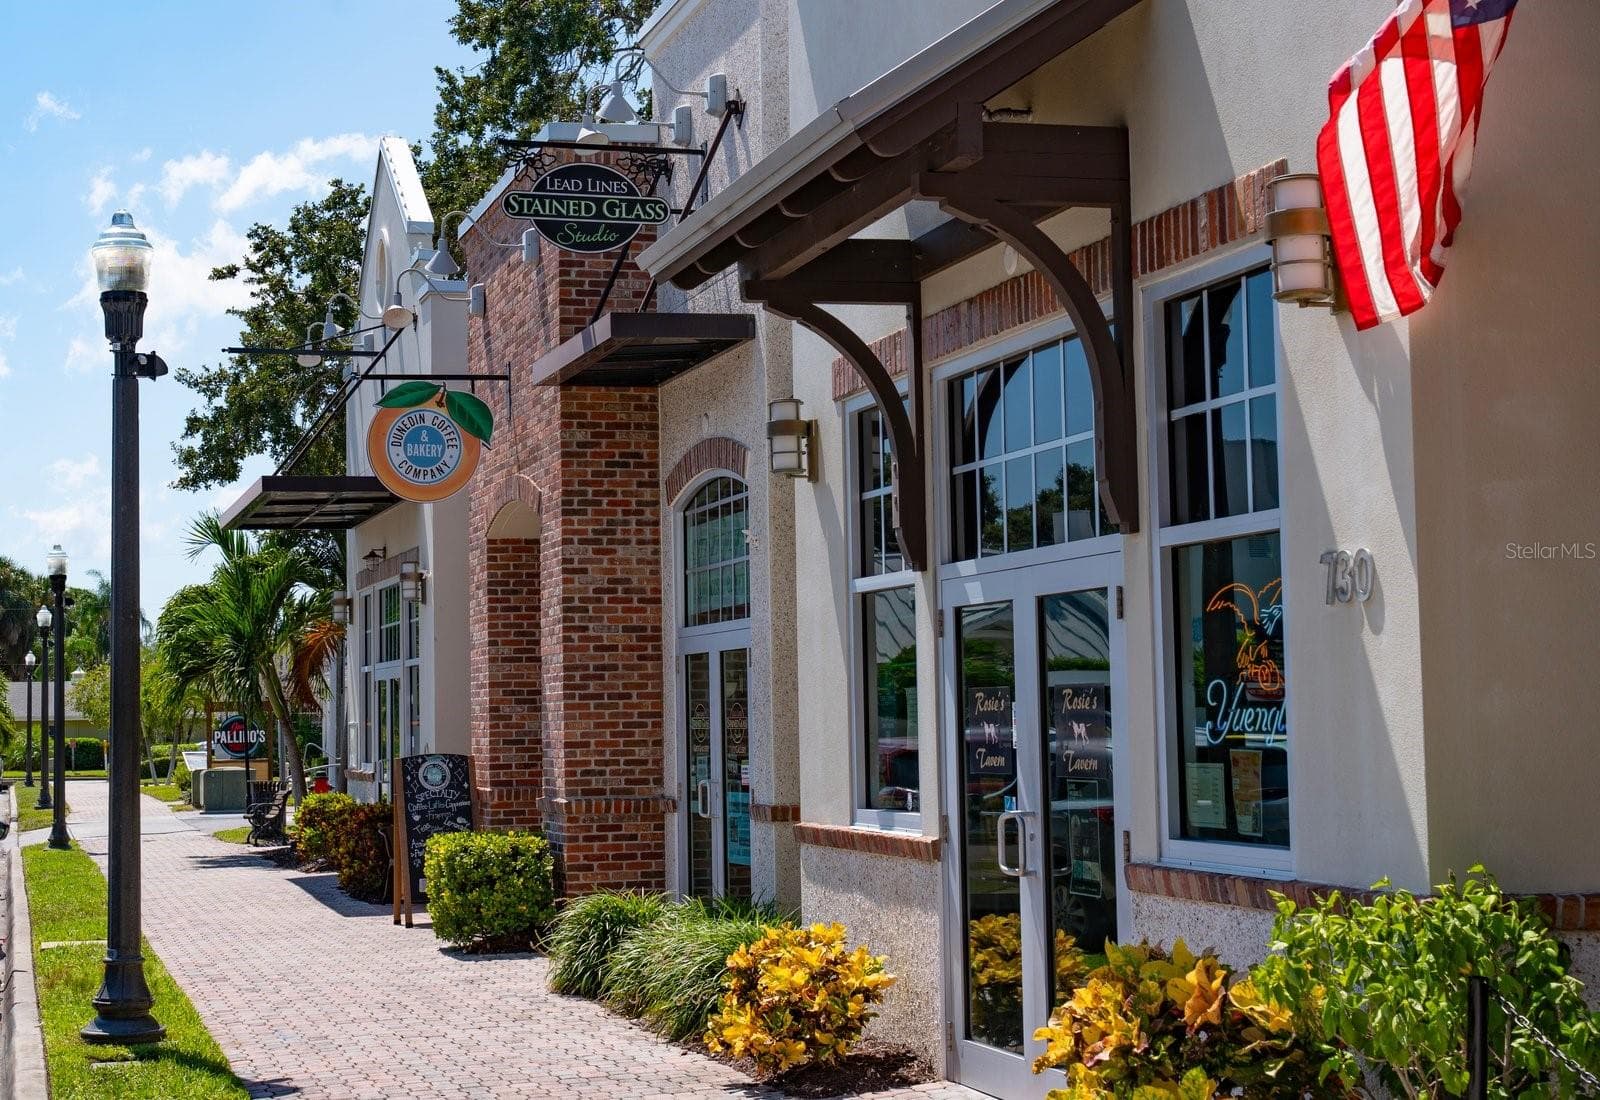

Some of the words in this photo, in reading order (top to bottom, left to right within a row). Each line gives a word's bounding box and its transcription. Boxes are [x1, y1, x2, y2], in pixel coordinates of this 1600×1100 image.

[546, 176, 582, 192] LEAD
[588, 178, 628, 194] LINES
[508, 194, 597, 217] STAINED
[602, 199, 665, 221] GLASS
[556, 222, 620, 245] Studio
[390, 413, 426, 447] DUNEDIN
[431, 415, 459, 450] COFFEE
[420, 429, 429, 442] &
[406, 443, 443, 458] BAKERY
[398, 459, 451, 480] COMPANY
[975, 691, 1006, 715] Rosie's
[1062, 687, 1098, 713] Rosie's
[975, 748, 1006, 769] Tavern
[1062, 750, 1098, 773] Tavern
